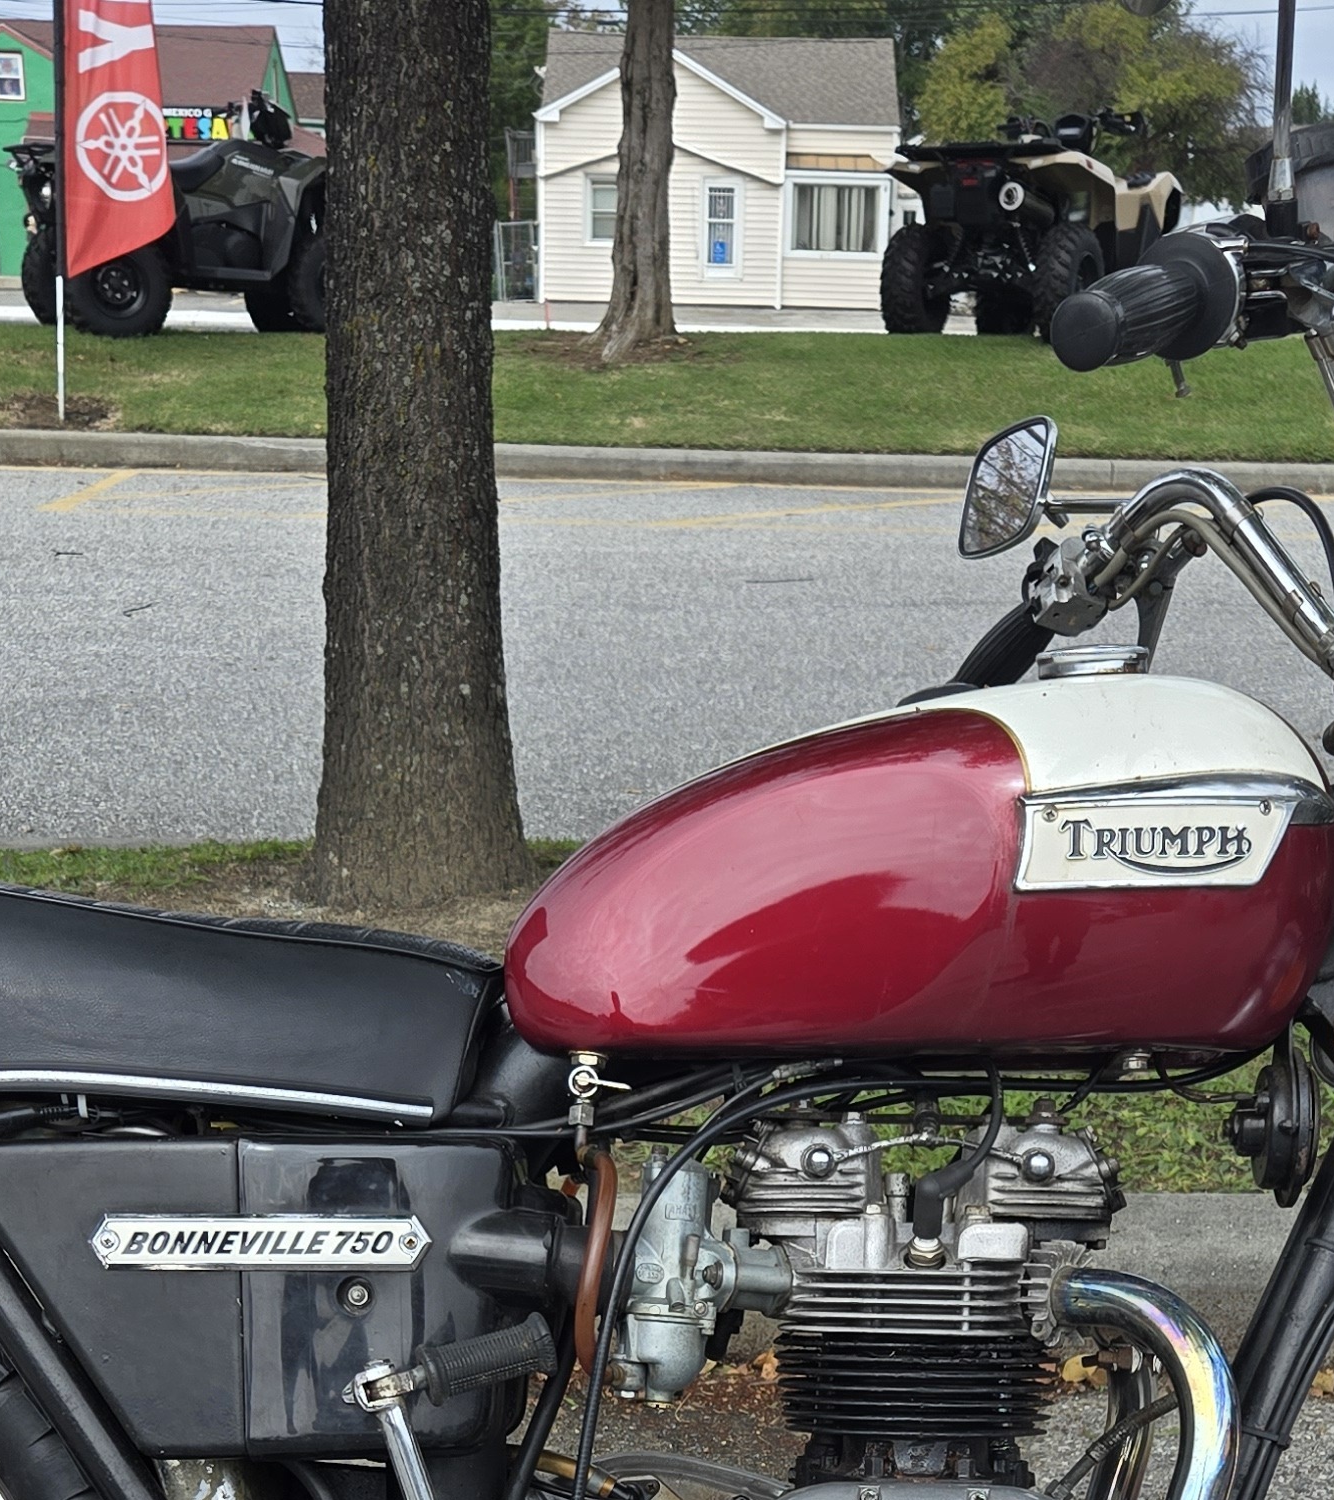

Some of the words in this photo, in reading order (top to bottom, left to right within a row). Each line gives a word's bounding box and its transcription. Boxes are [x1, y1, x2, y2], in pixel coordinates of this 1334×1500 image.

[78, 0, 155, 74] Y
[165, 116, 235, 140] TESA
[1059, 818, 1253, 875] TRIUMPH
[122, 1230, 326, 1255] BONNEVILLE
[331, 1230, 395, 1255] 750
